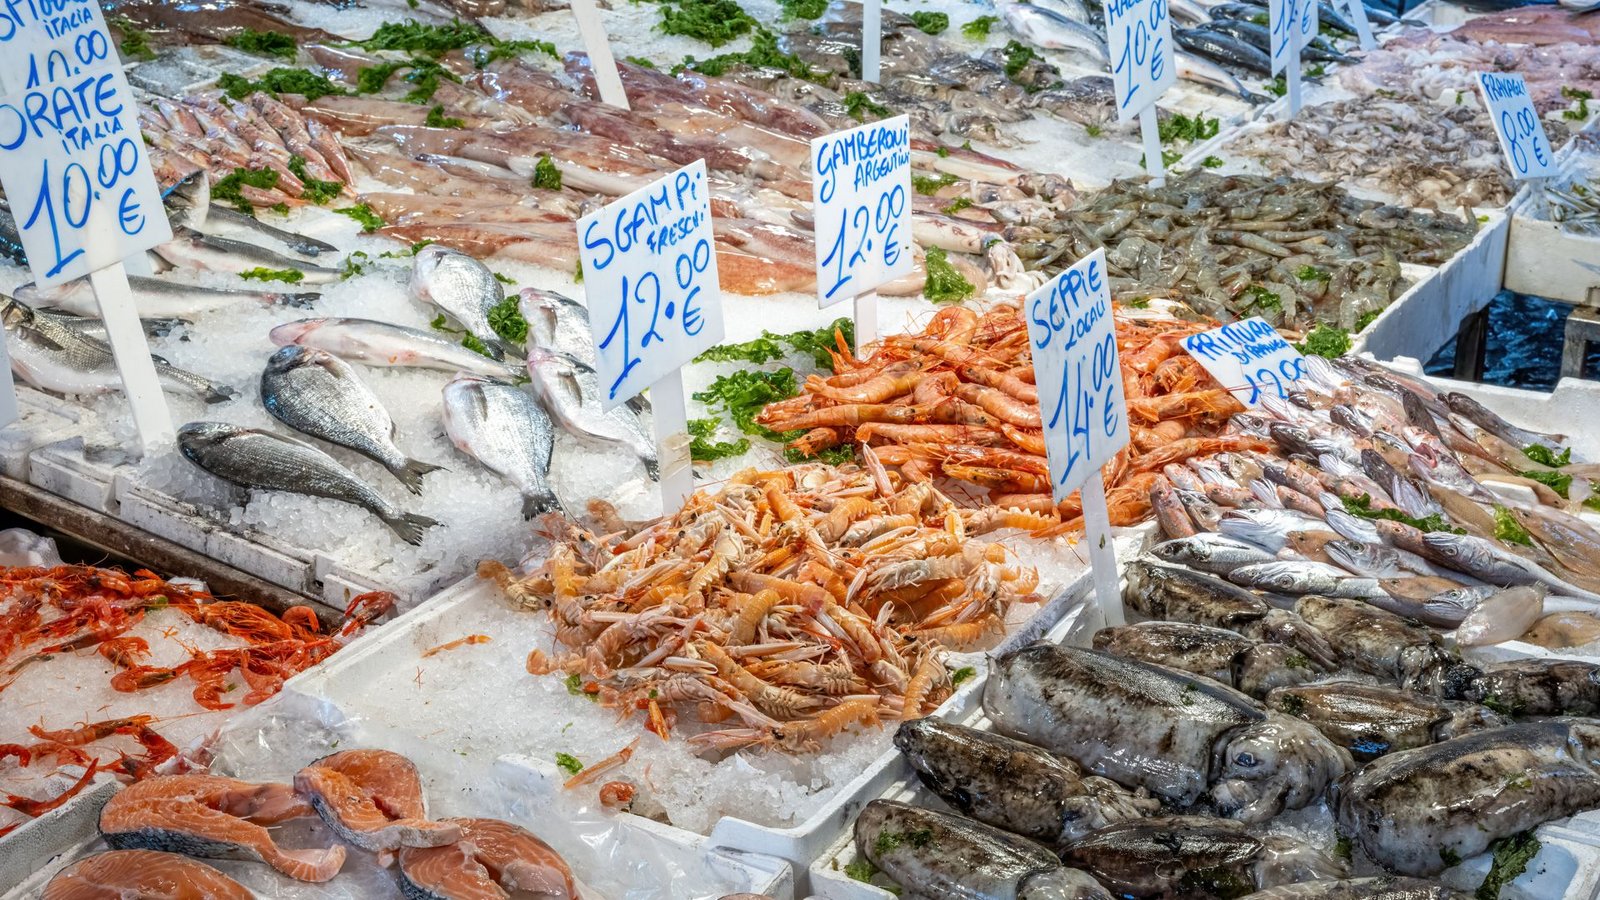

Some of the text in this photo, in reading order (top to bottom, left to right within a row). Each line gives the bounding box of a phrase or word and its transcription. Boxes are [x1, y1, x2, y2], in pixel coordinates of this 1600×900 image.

[1151, 37, 1164, 81] €
[0, 73, 123, 150] ORATE
[1502, 107, 1535, 174] 8.00
[1533, 136, 1548, 168] €
[23, 138, 138, 279] 10.00
[118, 187, 145, 236] €
[822, 185, 905, 299] 12.00
[884, 223, 900, 266] €
[599, 239, 710, 401] 12.00
[683, 286, 705, 337] €
[1049, 333, 1115, 486] 14.00
[1104, 383, 1118, 438] €
